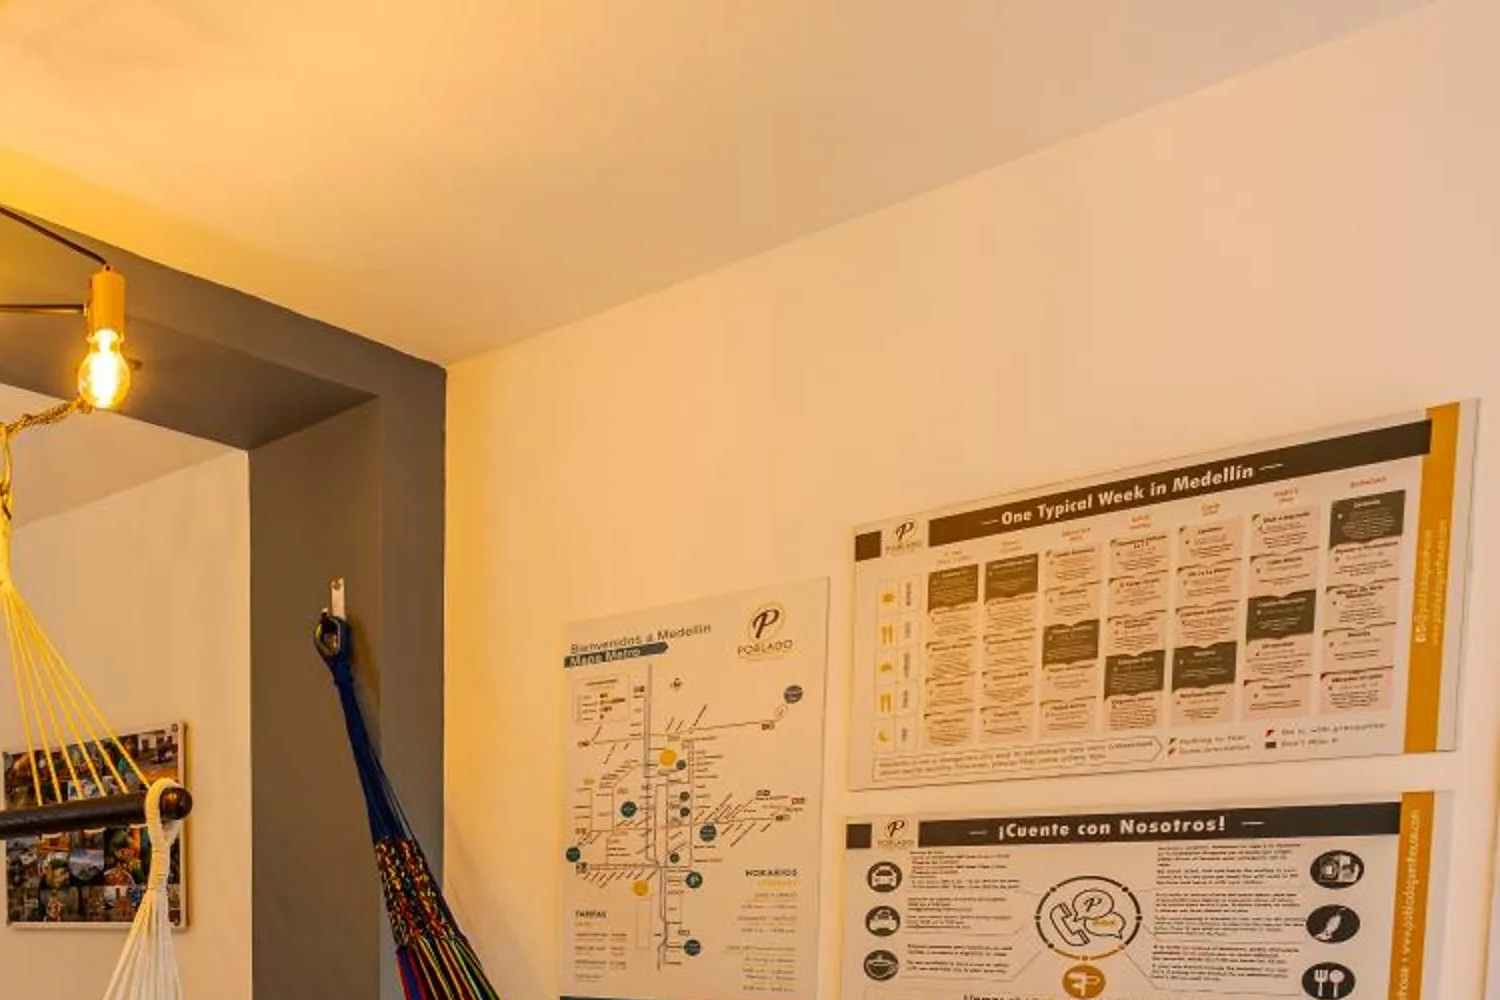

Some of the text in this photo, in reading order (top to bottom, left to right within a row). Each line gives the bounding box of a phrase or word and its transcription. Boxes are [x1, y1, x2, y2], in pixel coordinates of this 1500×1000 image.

[1001, 510, 1033, 526] One
[1037, 495, 1093, 522] Typical
[1099, 484, 1145, 506] Week
[1149, 480, 1168, 497] in
[998, 816, 1227, 841] ¡Cuente con Nosotros!
